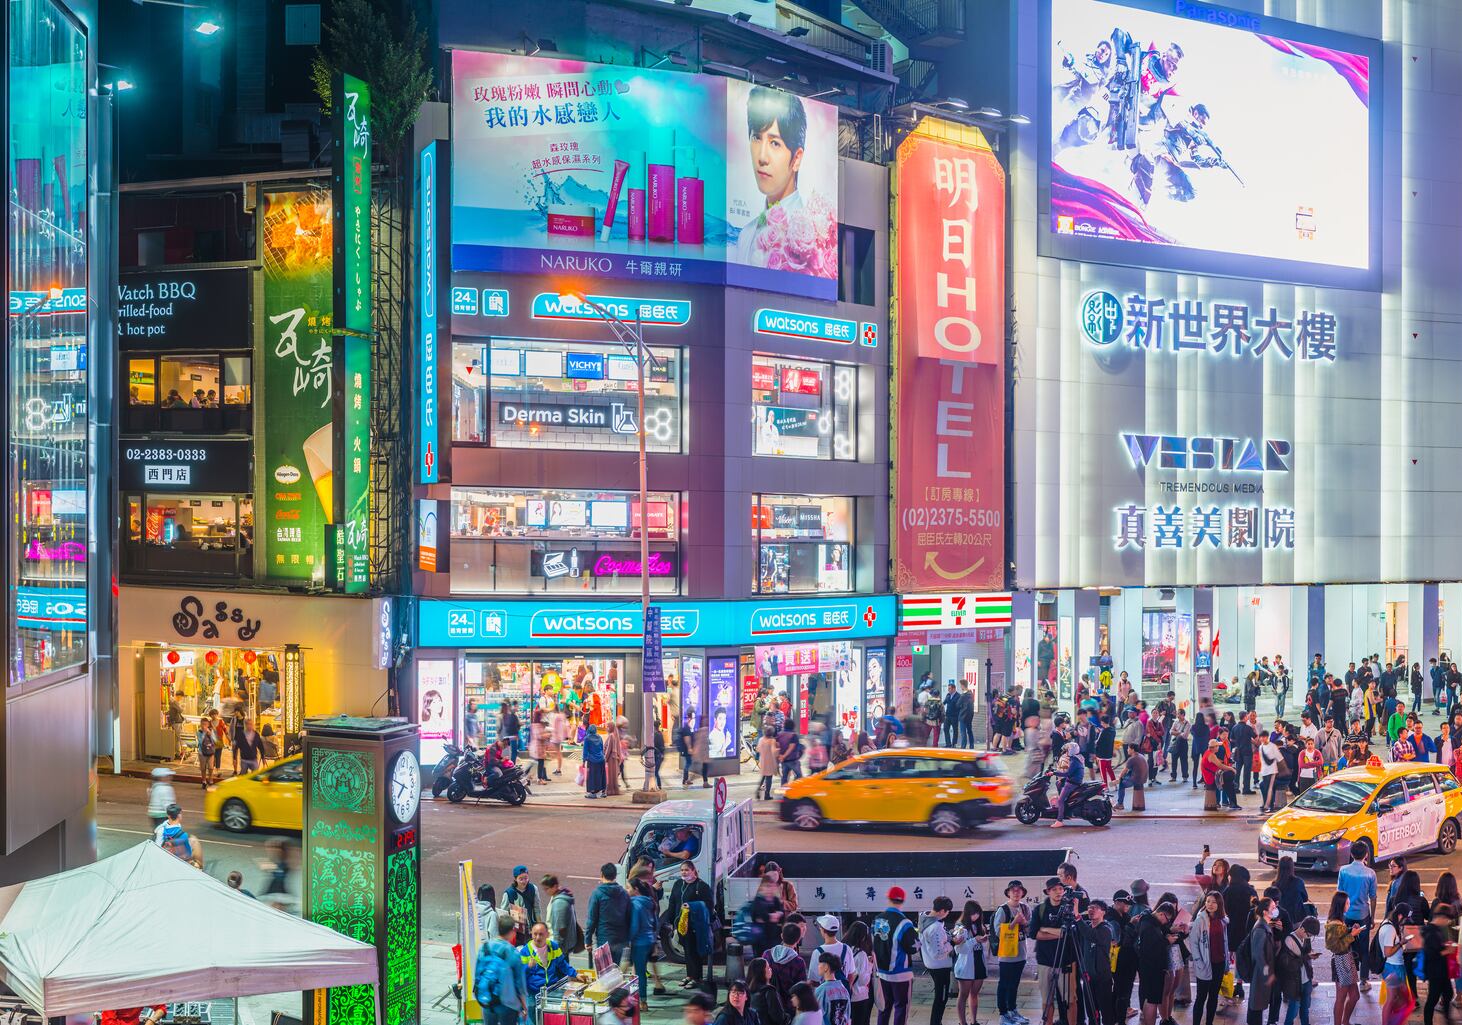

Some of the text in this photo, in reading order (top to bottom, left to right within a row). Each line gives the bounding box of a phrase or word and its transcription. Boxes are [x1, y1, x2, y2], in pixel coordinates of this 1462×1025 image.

[1174, 0, 1261, 30] Panasonic
[474, 80, 613, 103] 玫瑰粉嫩 瞬間心動
[484, 101, 621, 129] 我的水感戀人
[552, 222, 578, 232] NARUKO
[626, 260, 682, 277] 牛爾親研
[158, 282, 196, 299] BBQ
[454, 291, 471, 303] 24
[118, 303, 173, 318] rilled-food
[545, 297, 678, 319] watsons 屈臣氏
[127, 323, 165, 337] hot pot
[765, 315, 850, 338] watsons 屈臣氏
[1126, 294, 1337, 361] 新世界大樓
[569, 360, 596, 370] VICHY
[504, 407, 605, 424] Derma Skin
[126, 449, 206, 461] 02-2383-0333
[1122, 434, 1292, 472] WESTAR
[147, 467, 187, 481] 西門店
[1160, 481, 1265, 494] TREMENDOUS MEDIA
[800, 513, 821, 521] MISSHA
[902, 507, 1001, 531] (02)2375-5500
[1114, 505, 1295, 549] 真善美劇院
[917, 532, 993, 547] 屈臣氏左轉20公尺
[172, 596, 261, 641] Sassy
[451, 613, 469, 625] 24
[544, 616, 633, 631] watsons
[661, 616, 685, 630] 臣氏
[759, 610, 849, 628] watsons 屈臣氏
[1380, 821, 1422, 843] OTTERBOX
